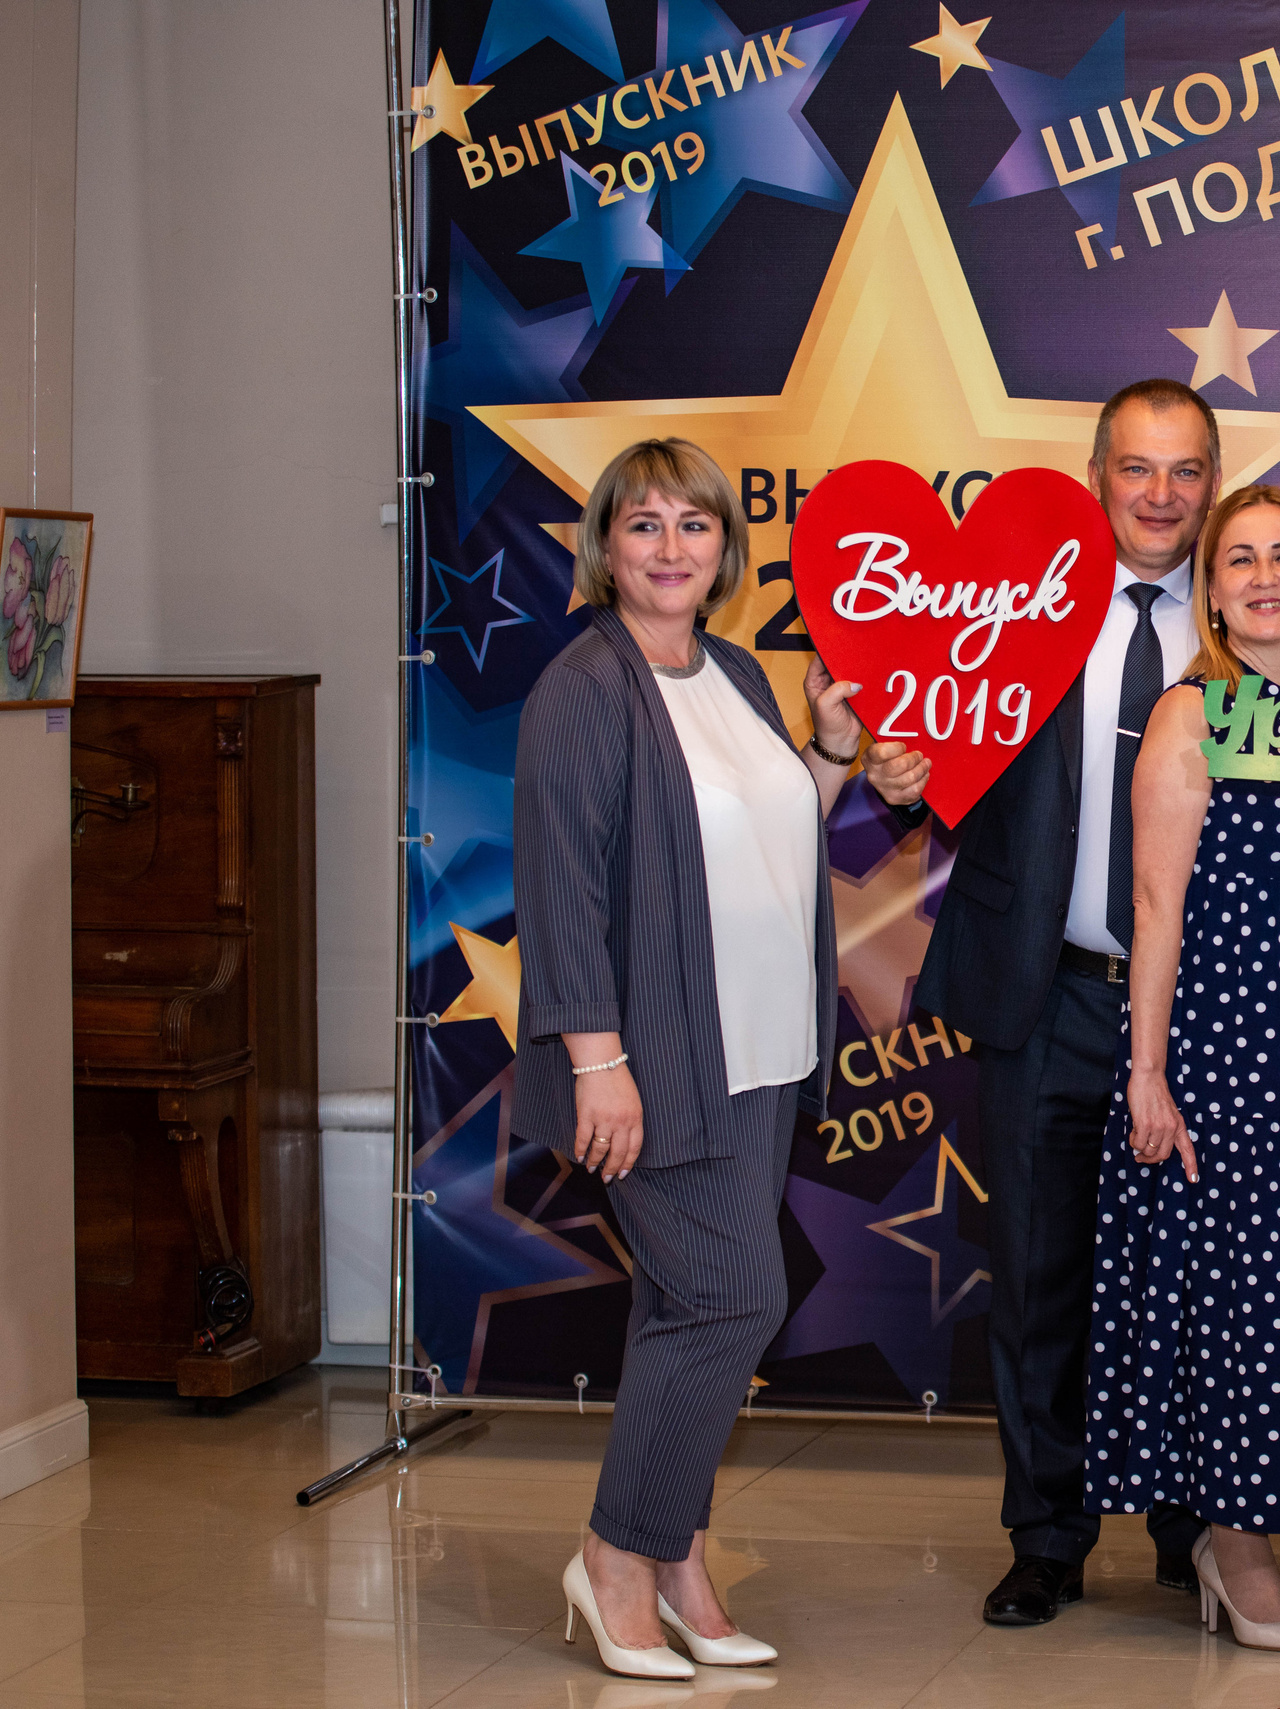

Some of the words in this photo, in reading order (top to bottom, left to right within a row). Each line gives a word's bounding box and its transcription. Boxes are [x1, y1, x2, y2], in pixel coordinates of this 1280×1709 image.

[457, 26, 806, 189] ВЫПУСКНИК
[590, 131, 705, 208] 2019
[1075, 223, 1125, 269] г.
[832, 532, 1081, 672] Выпуск
[877, 670, 1031, 746] 2019
[816, 1091, 934, 1164] 2019
